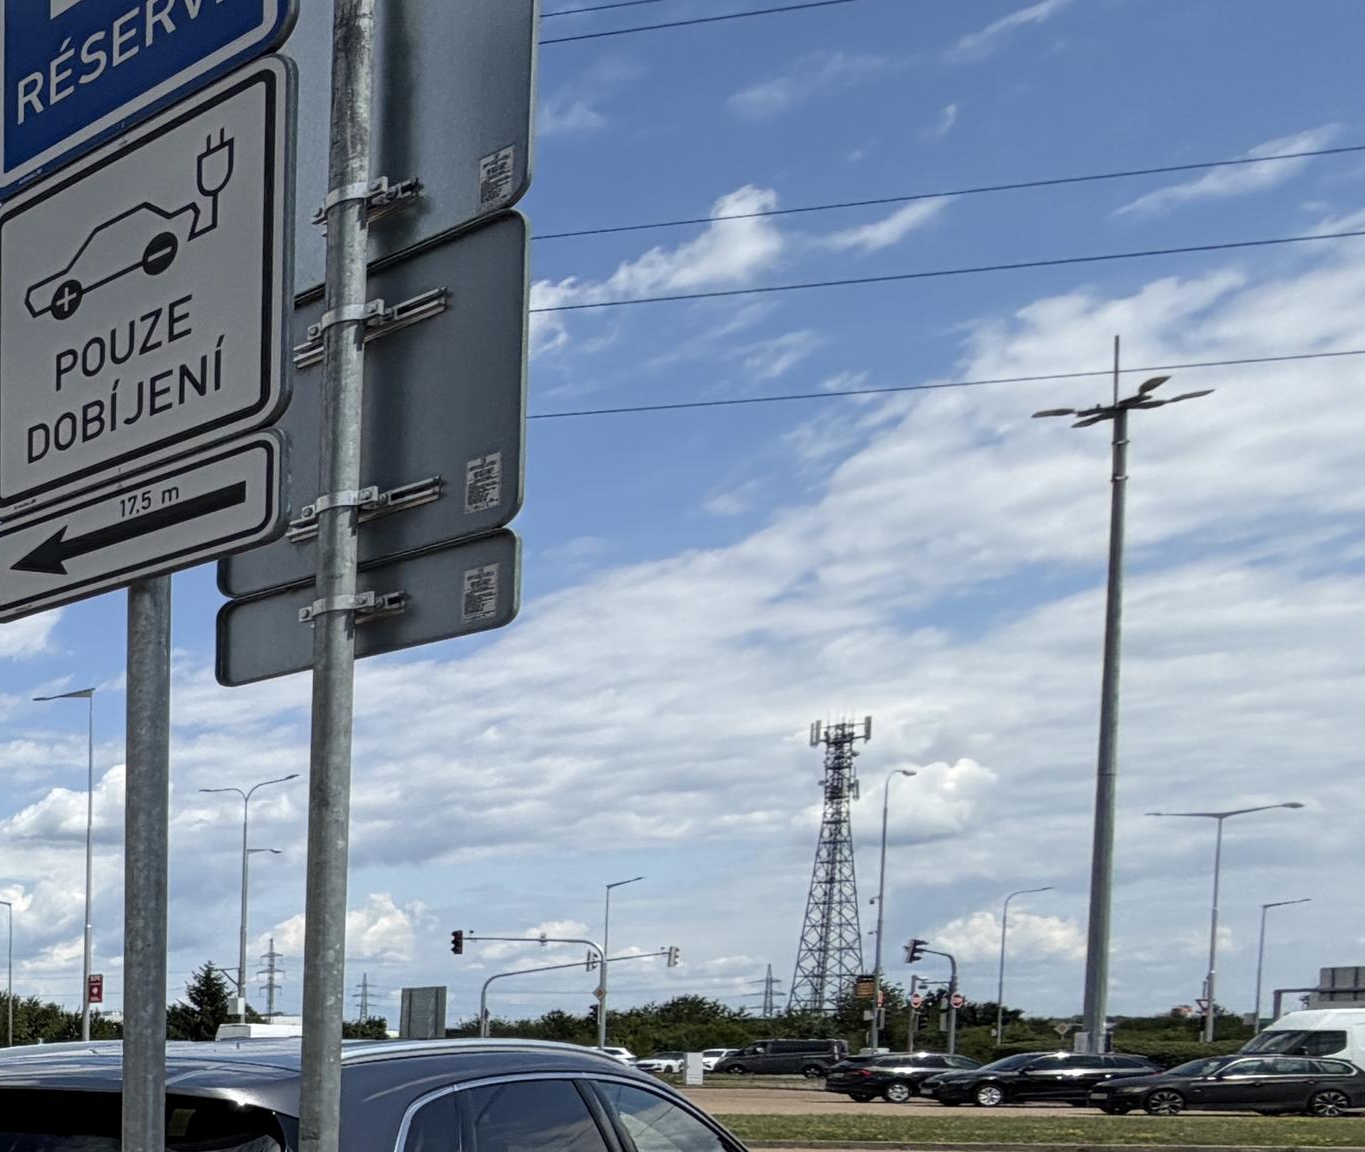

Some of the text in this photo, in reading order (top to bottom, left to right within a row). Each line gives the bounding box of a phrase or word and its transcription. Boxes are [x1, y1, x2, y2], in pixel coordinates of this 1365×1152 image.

[17, 0, 220, 125] RÉSERV
[55, 294, 193, 392] POUZE
[27, 334, 225, 465] DOBÍJENÍ
[119, 486, 180, 518] 17,5 m
